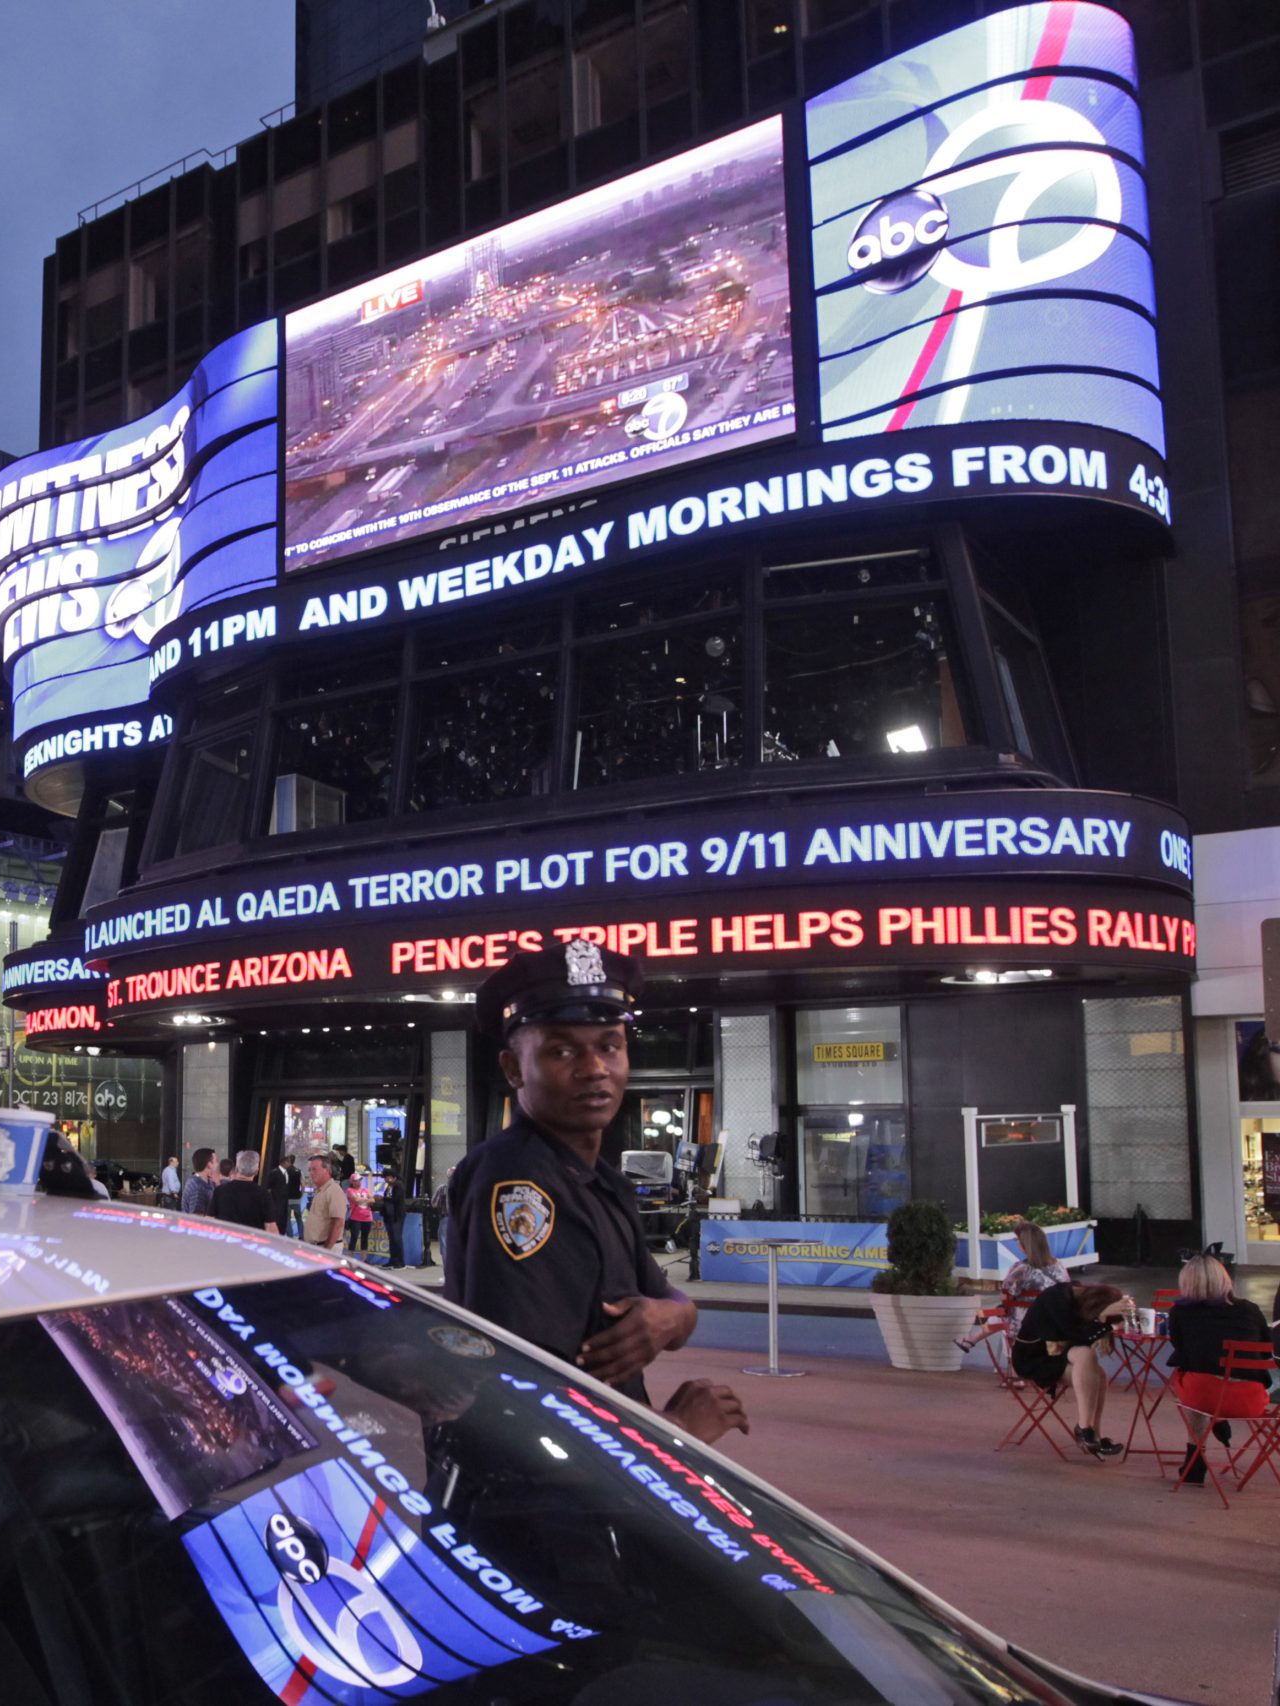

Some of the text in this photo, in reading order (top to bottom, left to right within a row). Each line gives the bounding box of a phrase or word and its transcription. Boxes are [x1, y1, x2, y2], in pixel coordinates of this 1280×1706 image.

[848, 209, 949, 269] abc
[363, 281, 420, 320] LIVE
[296, 542, 308, 554] TO
[309, 529, 353, 549] COINCIDE
[353, 522, 377, 540] WITH
[377, 516, 397, 532] THE
[423, 490, 492, 519] OBSERVANCE
[492, 484, 509, 498] OF
[508, 477, 529, 495] THE
[530, 471, 560, 488] SEPT.
[562, 466, 574, 478] 11
[575, 452, 629, 476] ATTACKS.
[630, 433, 691, 459] OFFICIALS
[692, 424, 717, 442] SAY
[717, 416, 751, 435] THEY
[752, 408, 780, 425] ARE
[188, 606, 277, 659] 11PM
[298, 585, 388, 631] AND
[399, 521, 616, 611] WEEKDAY
[627, 453, 934, 550] MORNINGS
[951, 444, 1108, 491] FROM
[91, 904, 191, 951] LAUNCHED
[196, 897, 231, 930] AL
[236, 880, 340, 923] QAEDA
[348, 863, 484, 909] TERROR
[495, 850, 594, 894] PLOT
[605, 840, 690, 883] FOR
[700, 830, 787, 876] 9/11
[803, 816, 1132, 866] ANNIVERSARY
[107, 979, 123, 1009] ST.
[125, 961, 221, 1004] TROUNCE
[226, 947, 353, 990] ARIZONA
[391, 929, 544, 975] PENCE'S
[710, 908, 865, 954] HELPS
[878, 906, 1078, 946] PHILLIES
[1087, 908, 1179, 953] RALLY
[815, 1044, 881, 1059] TIMES SQUARE
[43, 1090, 58, 1105] 23
[94, 1089, 128, 1108] abc
[723, 1241, 769, 1256] GOOD
[775, 1243, 850, 1260] MORNING
